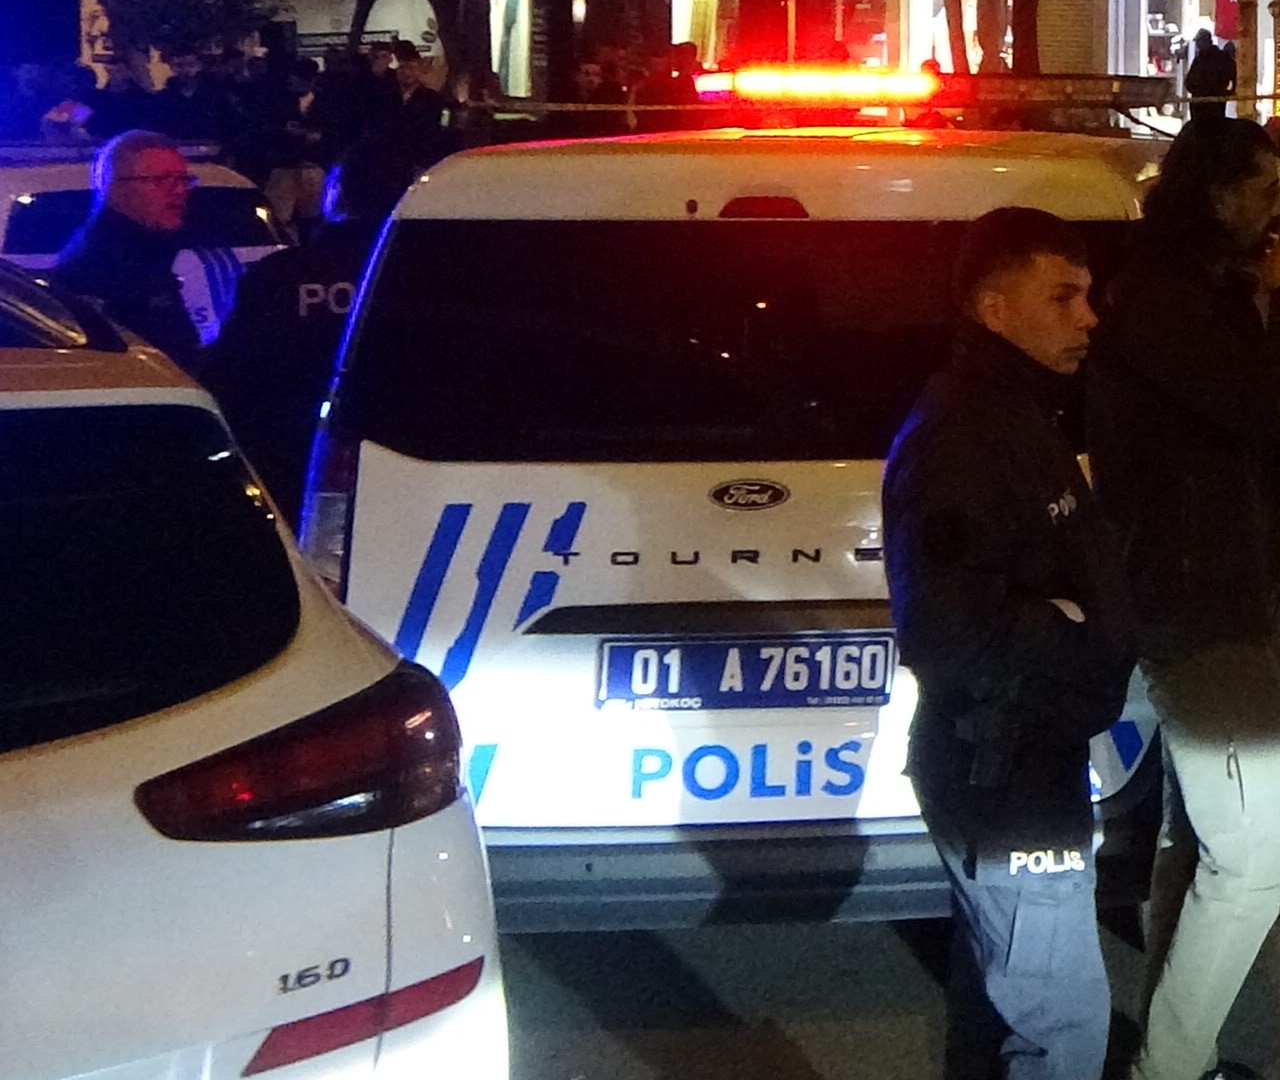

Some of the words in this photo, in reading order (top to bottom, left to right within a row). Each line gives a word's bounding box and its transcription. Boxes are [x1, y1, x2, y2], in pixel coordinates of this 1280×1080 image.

[723, 484, 772, 505] Ford
[553, 548, 882, 566] TOURNE
[631, 648, 681, 695] 01
[719, 647, 744, 693] A
[760, 643, 886, 692] 76160
